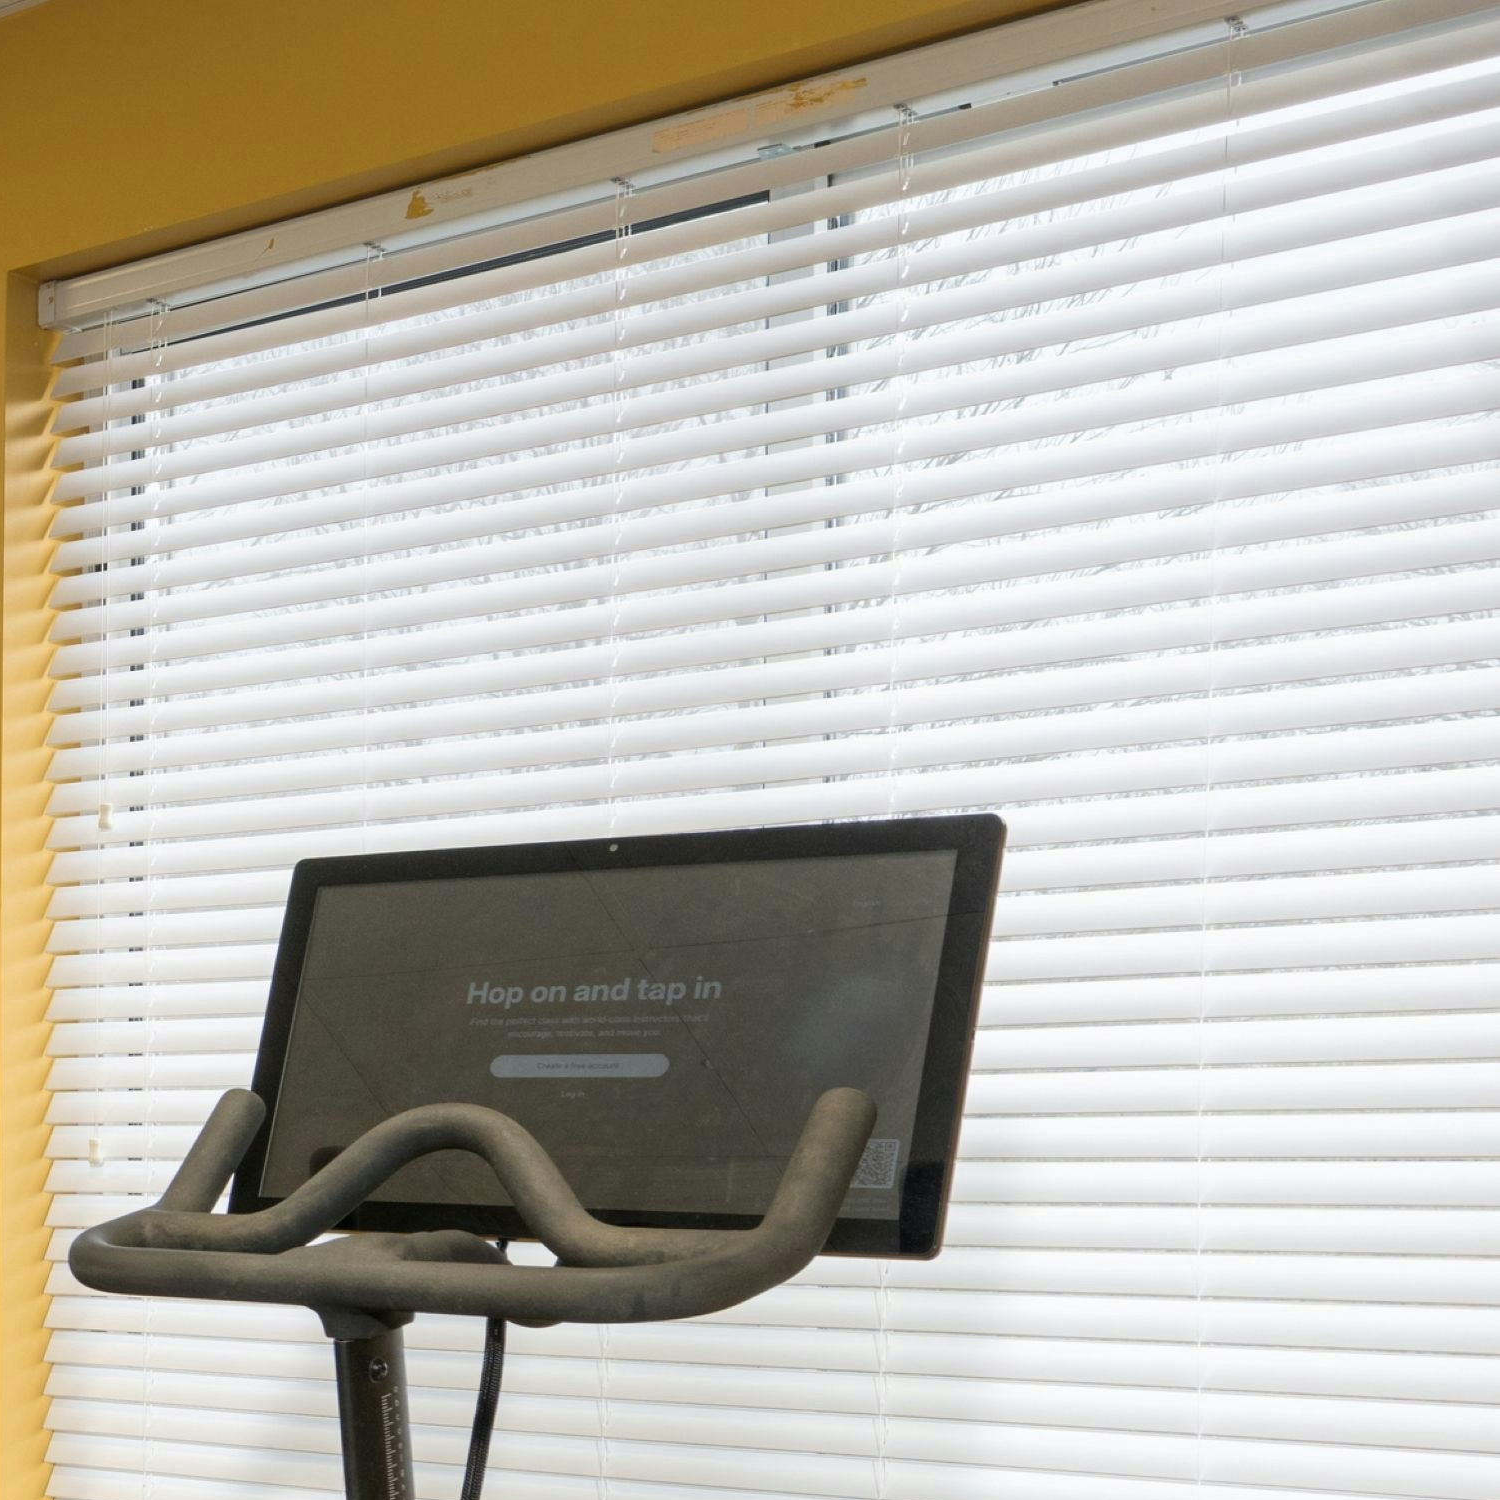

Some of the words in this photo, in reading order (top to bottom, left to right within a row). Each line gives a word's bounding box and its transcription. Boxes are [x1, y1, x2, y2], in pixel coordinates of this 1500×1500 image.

[467, 981, 524, 1009] Hop
[530, 983, 566, 1003] on
[573, 977, 631, 1002] and
[637, 979, 687, 1006] tap
[693, 976, 722, 1000] in
